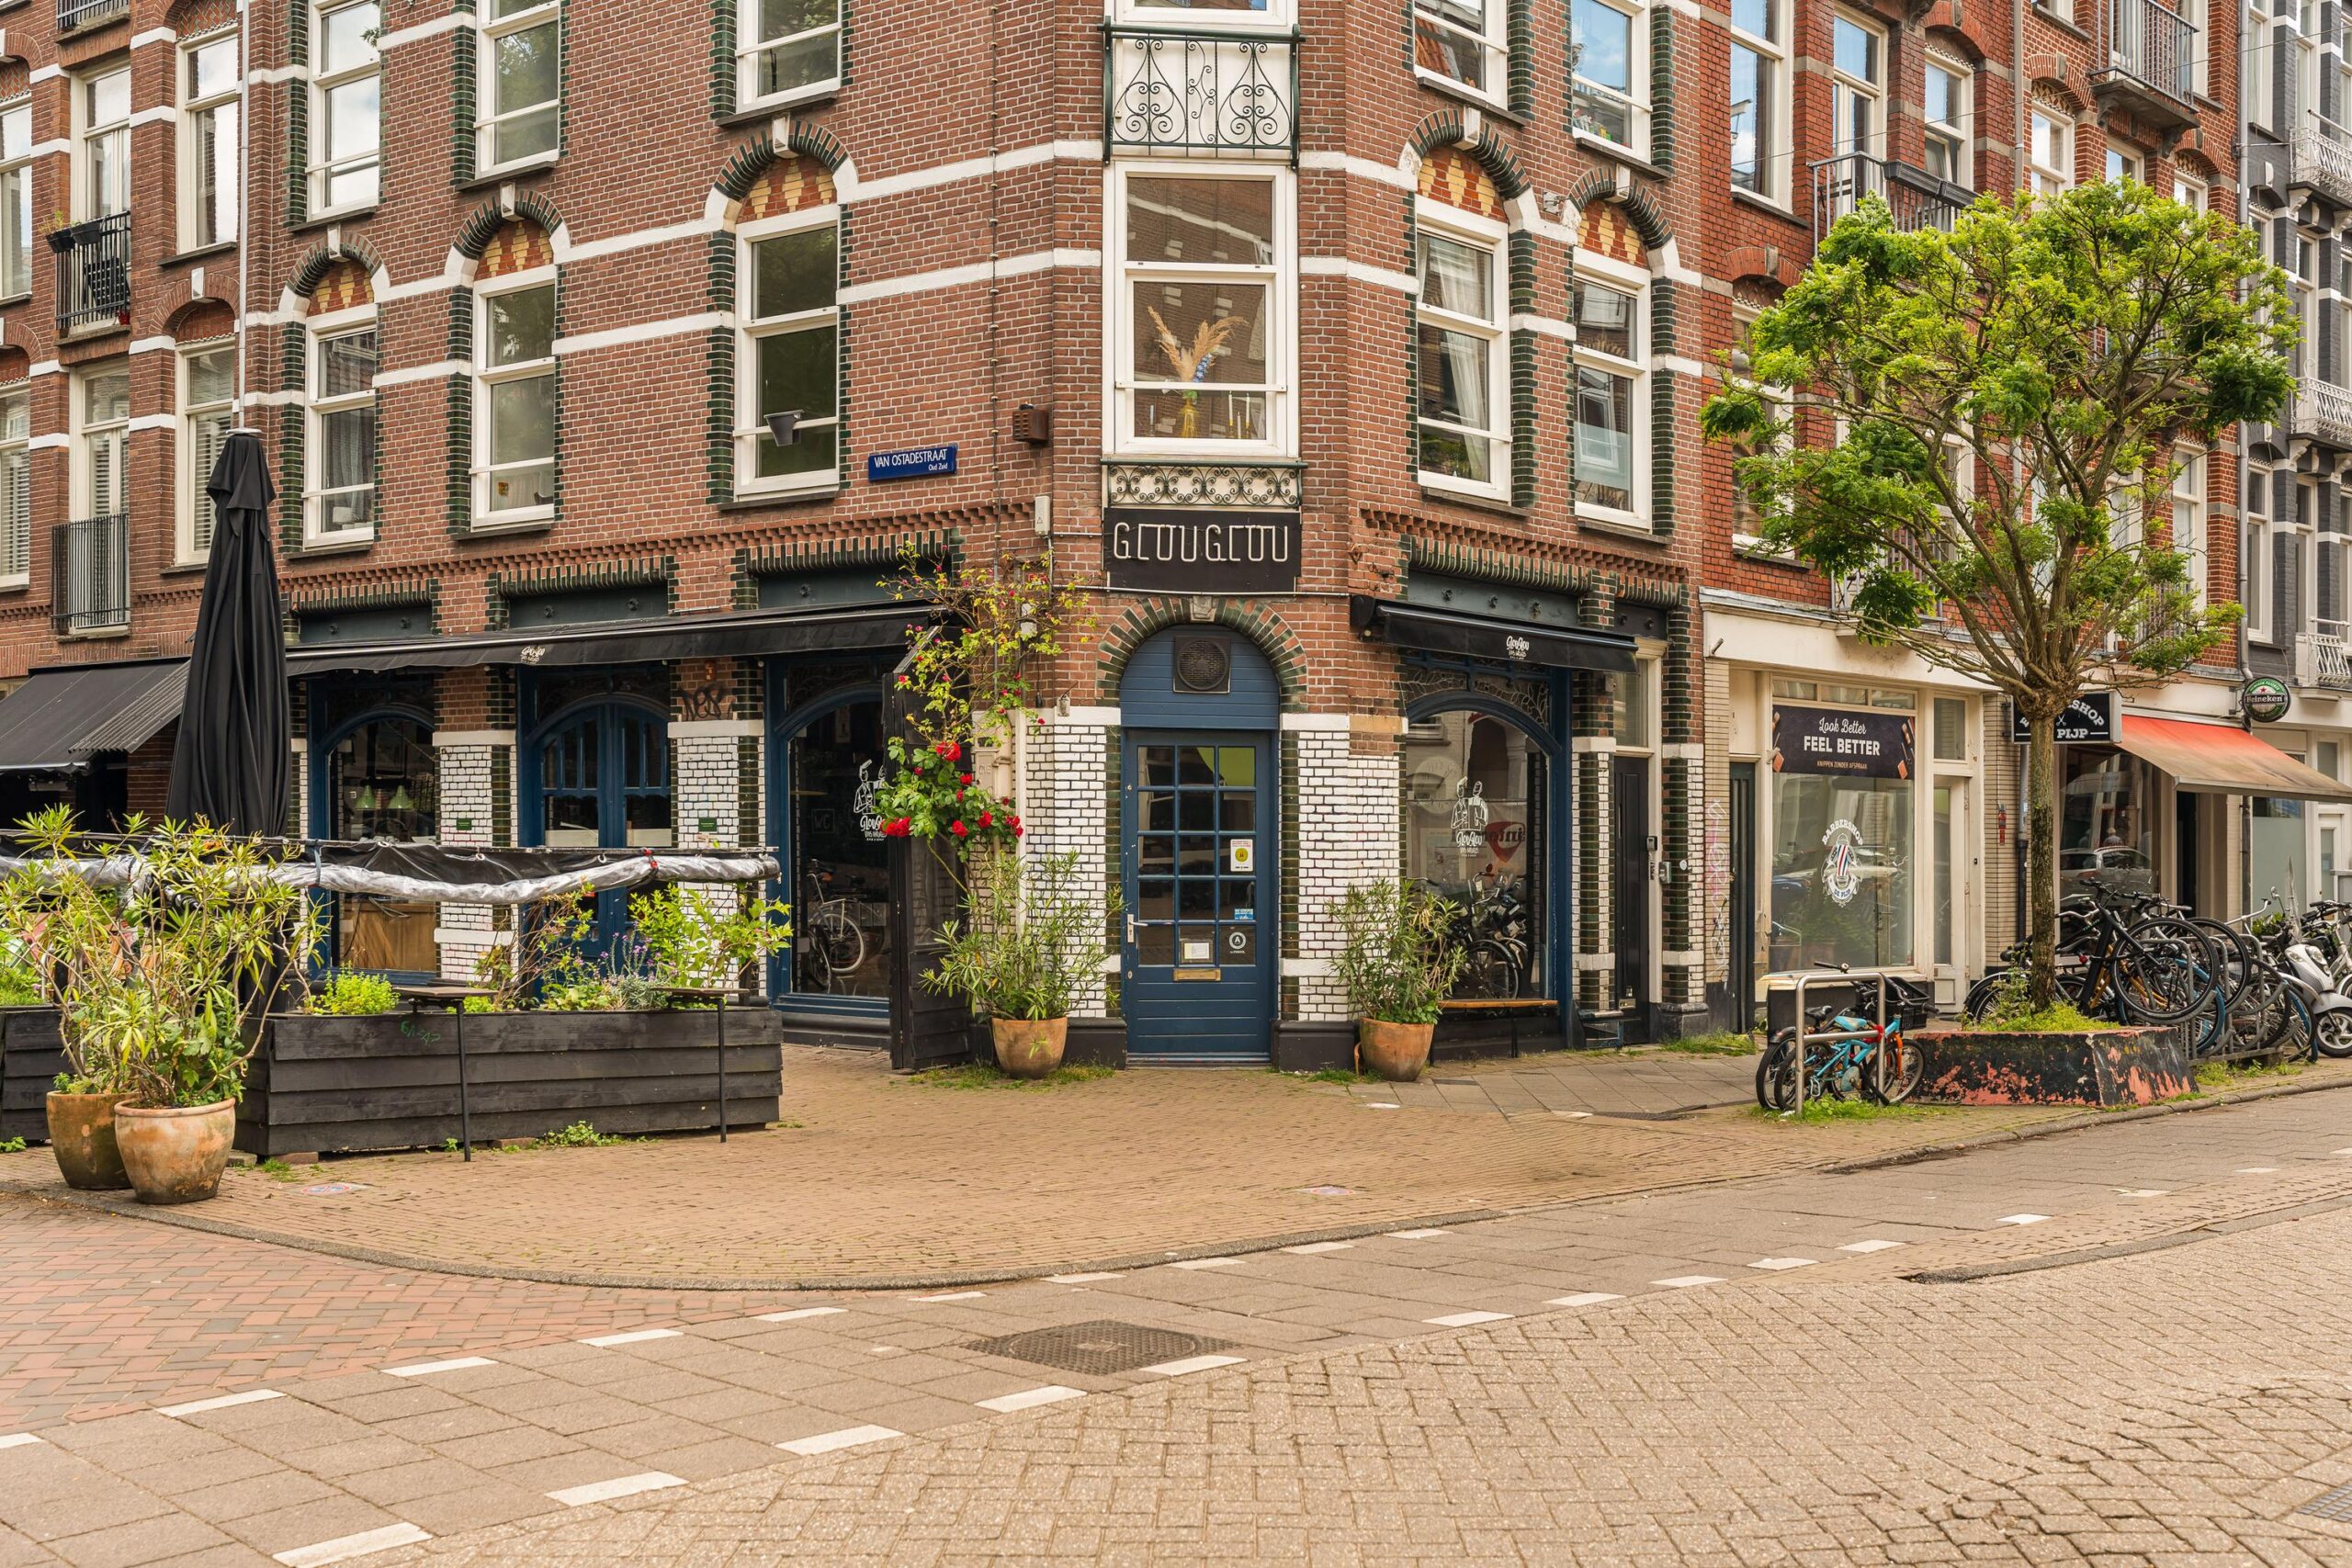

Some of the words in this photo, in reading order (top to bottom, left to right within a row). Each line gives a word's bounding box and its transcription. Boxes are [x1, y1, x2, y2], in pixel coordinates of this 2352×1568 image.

[874, 456, 889, 468] VAN
[891, 449, 947, 466] OSTADESTRAAT
[1818, 716, 1838, 733] Look
[1841, 718, 1866, 734] Better
[2056, 728, 2088, 739] PIJP
[1804, 735, 1833, 752] FEEL
[1838, 738, 1880, 756] BETTER
[1822, 818, 1863, 845] BARBERSHOP
